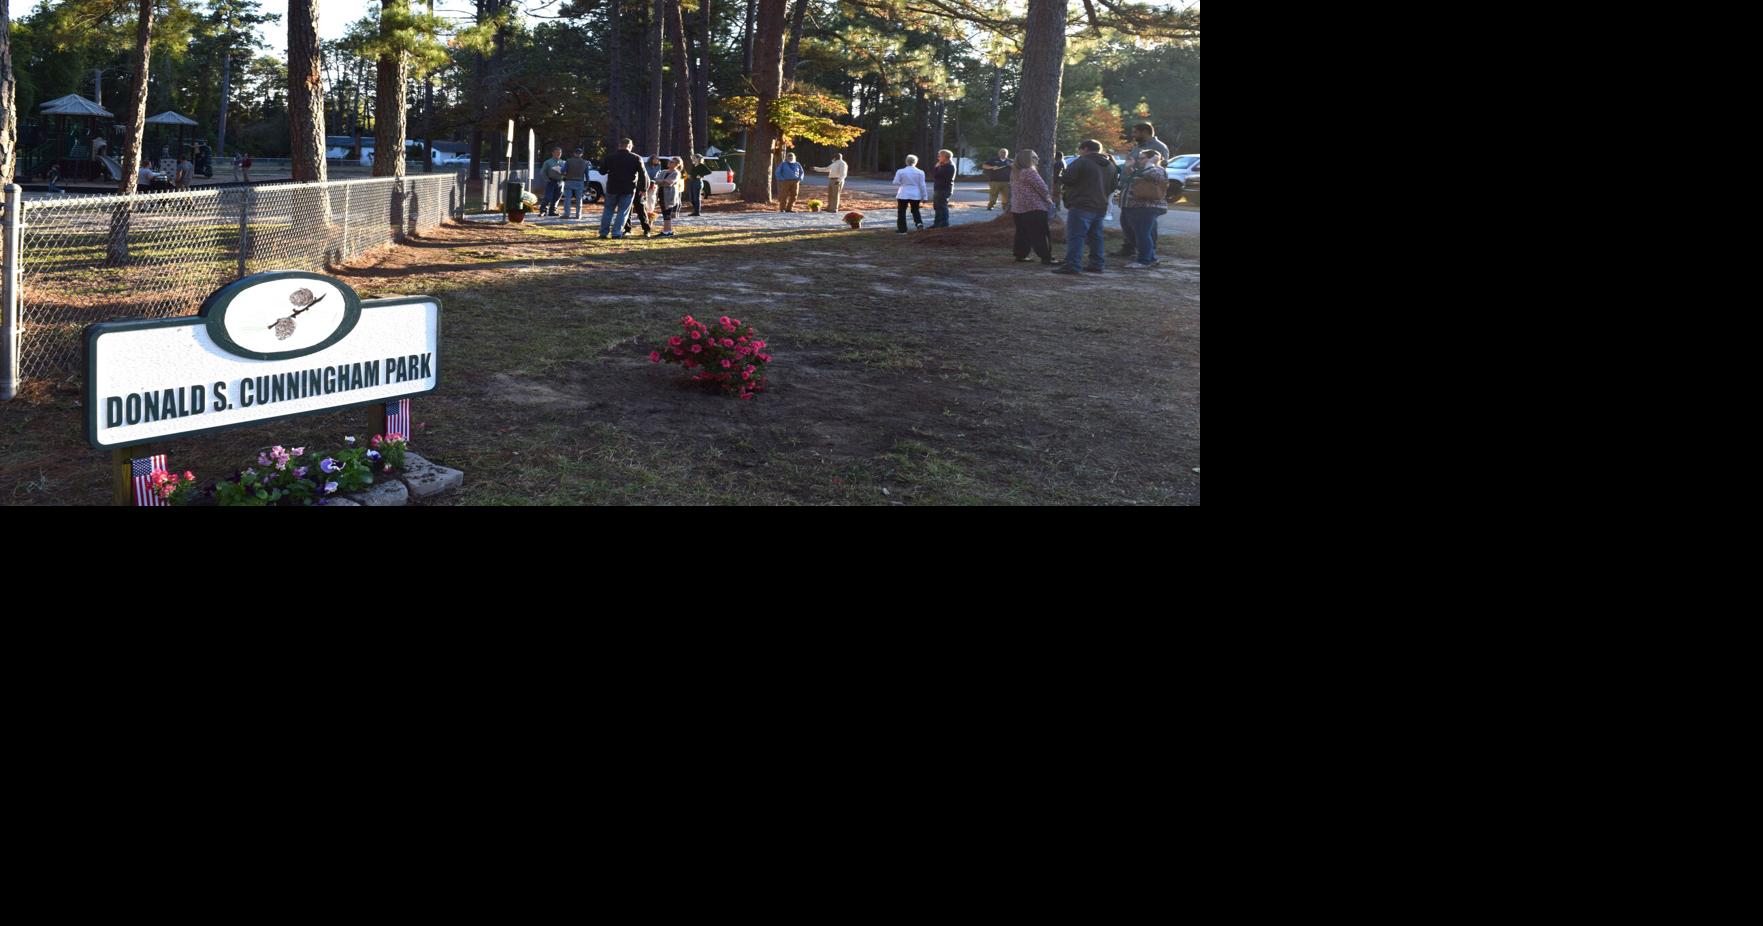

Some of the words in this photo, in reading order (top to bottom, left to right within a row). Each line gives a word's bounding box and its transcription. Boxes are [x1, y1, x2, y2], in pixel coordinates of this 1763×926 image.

[106, 384, 206, 428] DONALD
[213, 380, 233, 412] S.
[240, 359, 380, 408] CUNNINGHAM
[385, 352, 432, 385] PARK
